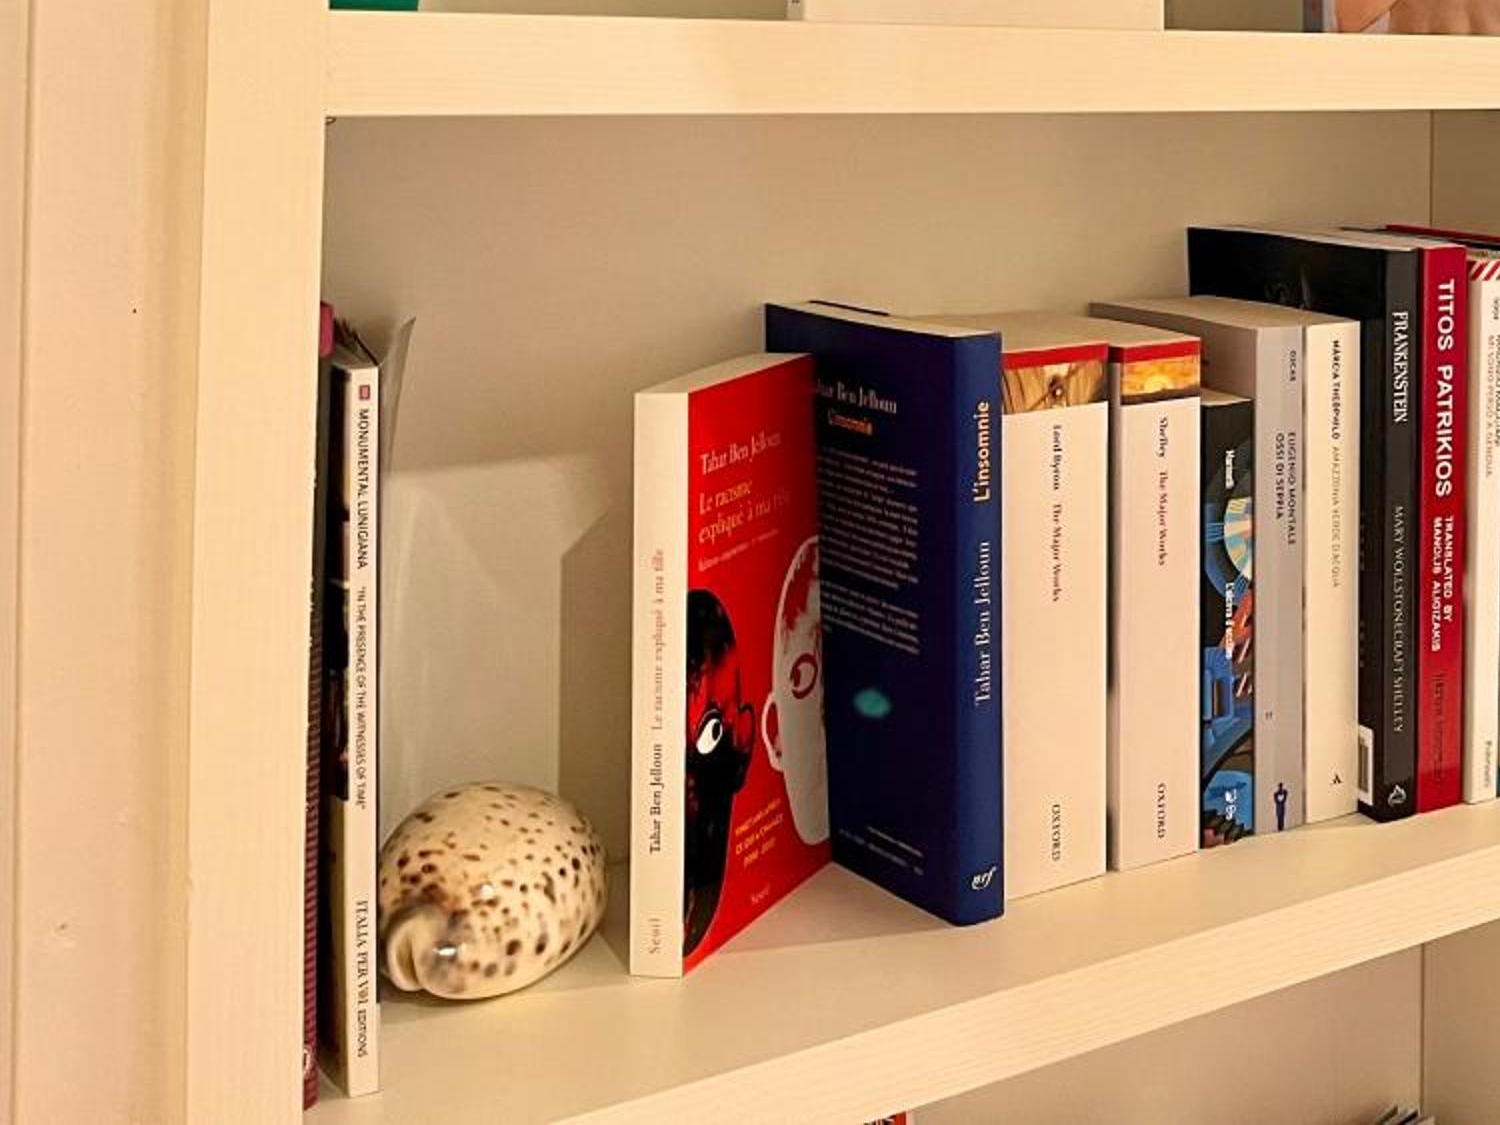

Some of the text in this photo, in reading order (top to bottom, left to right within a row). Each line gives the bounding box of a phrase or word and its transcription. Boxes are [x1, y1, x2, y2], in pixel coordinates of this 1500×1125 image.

[1435, 279, 1455, 498] TITOS PATRIKIOS
[729, 442, 749, 464] Ben
[1275, 432, 1285, 520] OSSI DI SEPPIA
[357, 407, 369, 570] MONUMENTAL LUNIGIANA
[699, 492, 713, 515] Le
[1050, 424, 1063, 602] Lord Byron The Major Works
[1155, 416, 1169, 566] Shelley The Major Works
[1286, 431, 1297, 545] EUGENIO MONTALE
[1391, 311, 1409, 733] FRANKENSTEIN MARY WOLLSTONECRAFT SHELLEY
[1431, 516, 1443, 575] MANOLIS
[972, 400, 991, 707] Tahar Ben Jelloun L'insomnie
[1442, 516, 1454, 623] TRANSLATED BY
[355, 603, 367, 621] THE
[355, 624, 367, 673] PRESENCE
[355, 675, 366, 688] OF
[355, 690, 367, 709] THE
[649, 744, 665, 790] Jelloun
[649, 790, 662, 816] Ben
[1157, 782, 1167, 840] OXFORD
[1051, 804, 1062, 863] OXFORD
[355, 900, 369, 948] ITALIA
[648, 917, 662, 956] Seuil
[357, 950, 369, 979] PER
[357, 1008, 368, 1058] EDITIONS
